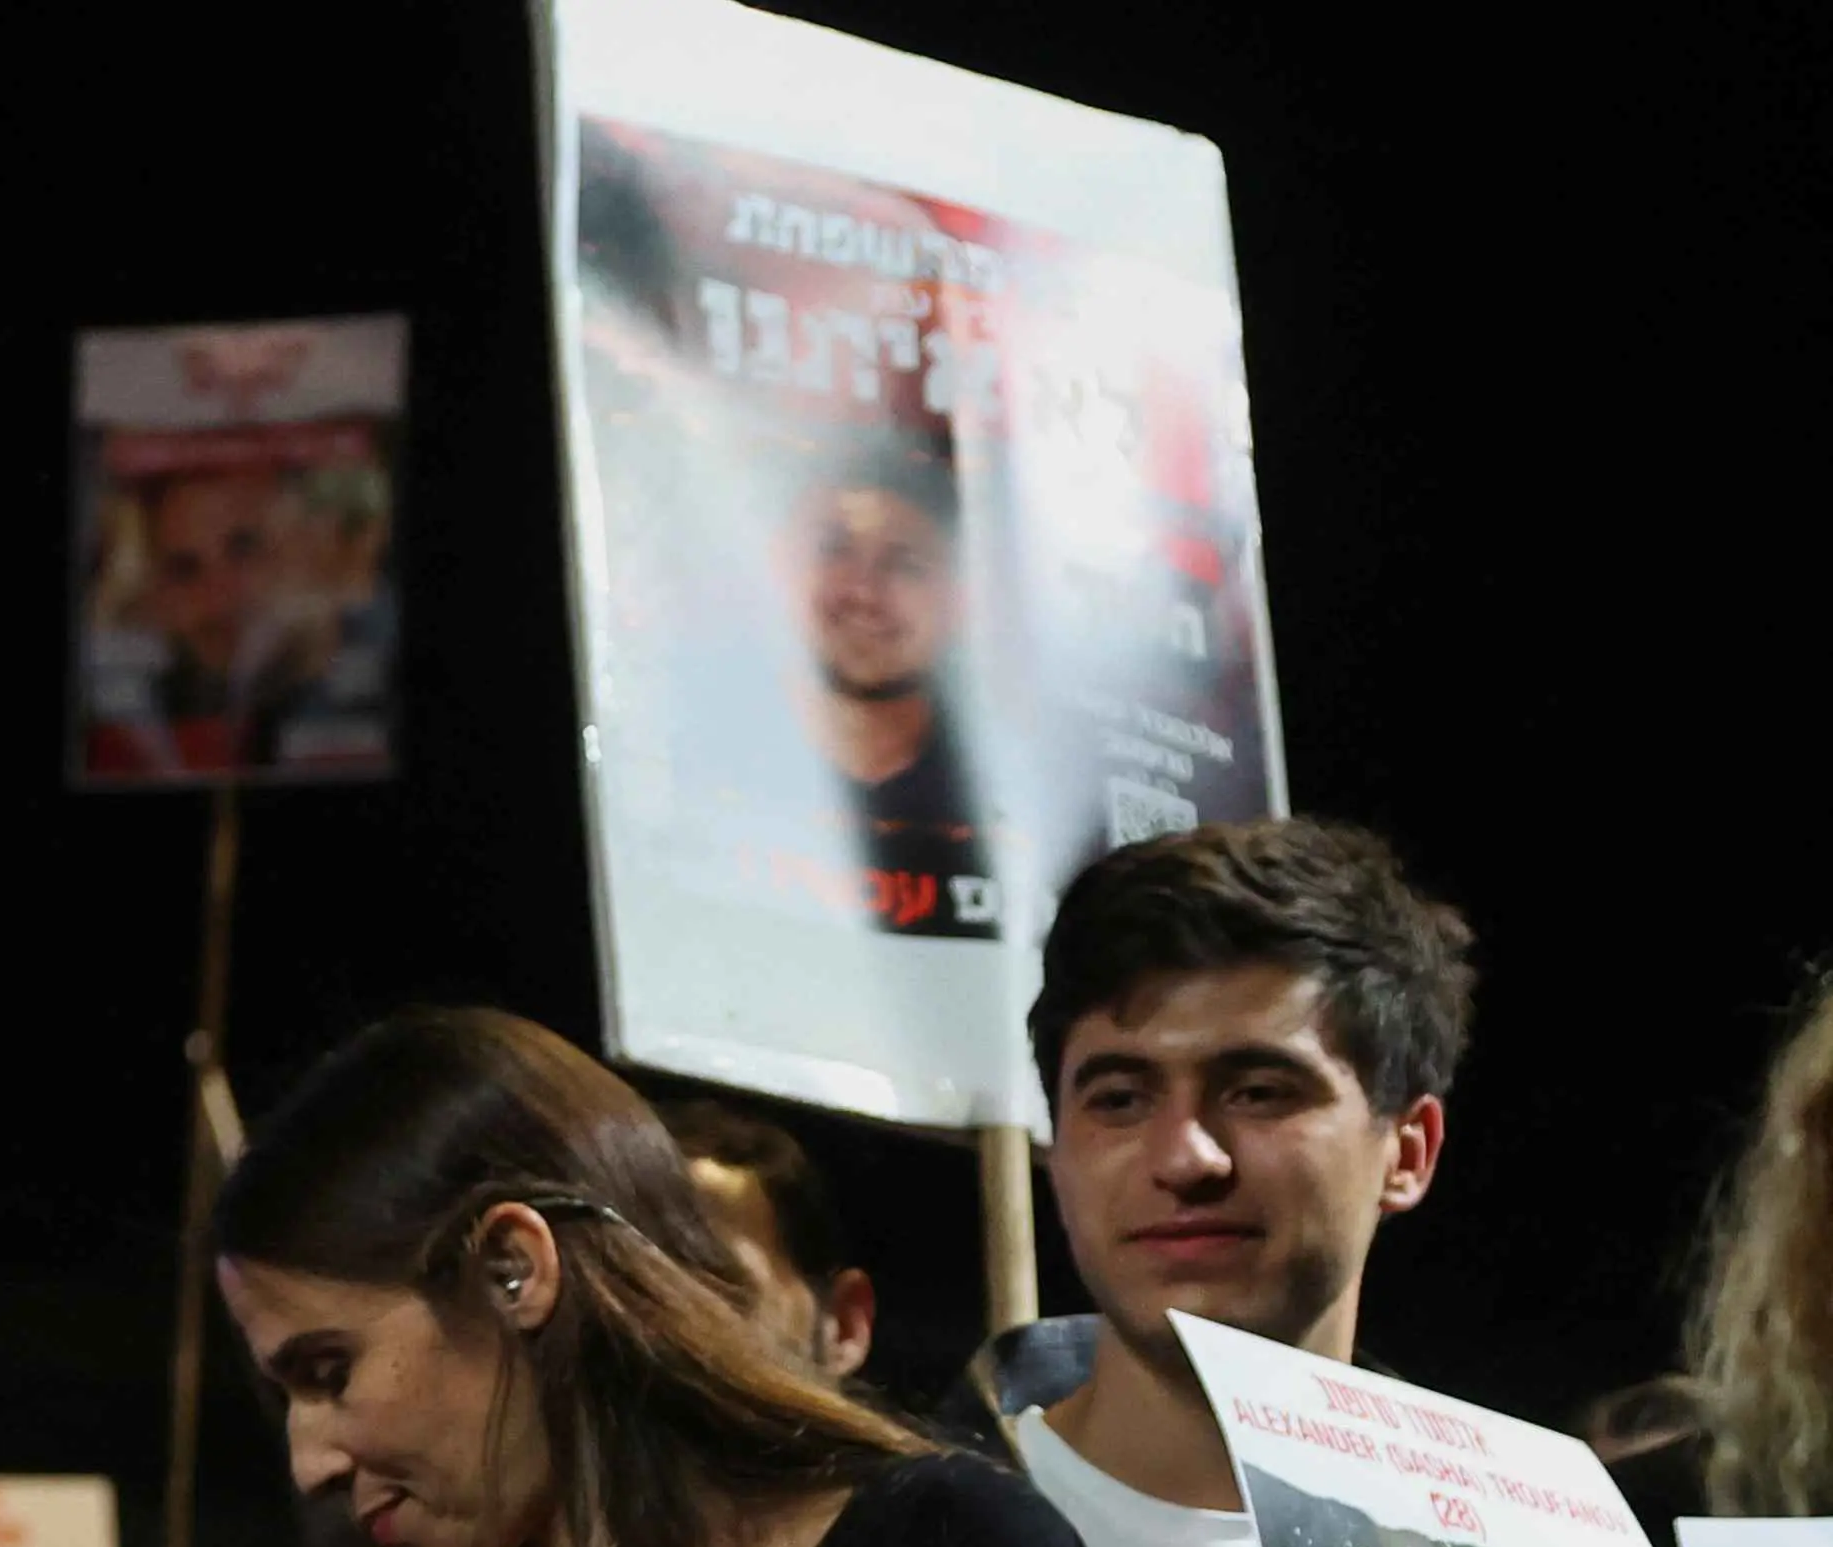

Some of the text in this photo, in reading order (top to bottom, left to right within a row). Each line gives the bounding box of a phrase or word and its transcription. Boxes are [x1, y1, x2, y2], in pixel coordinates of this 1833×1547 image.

[1234, 1396, 1382, 1463] ALEXANDER
[1386, 1442, 1487, 1497] (SASHA)
[1429, 1490, 1487, 1542] (28)
